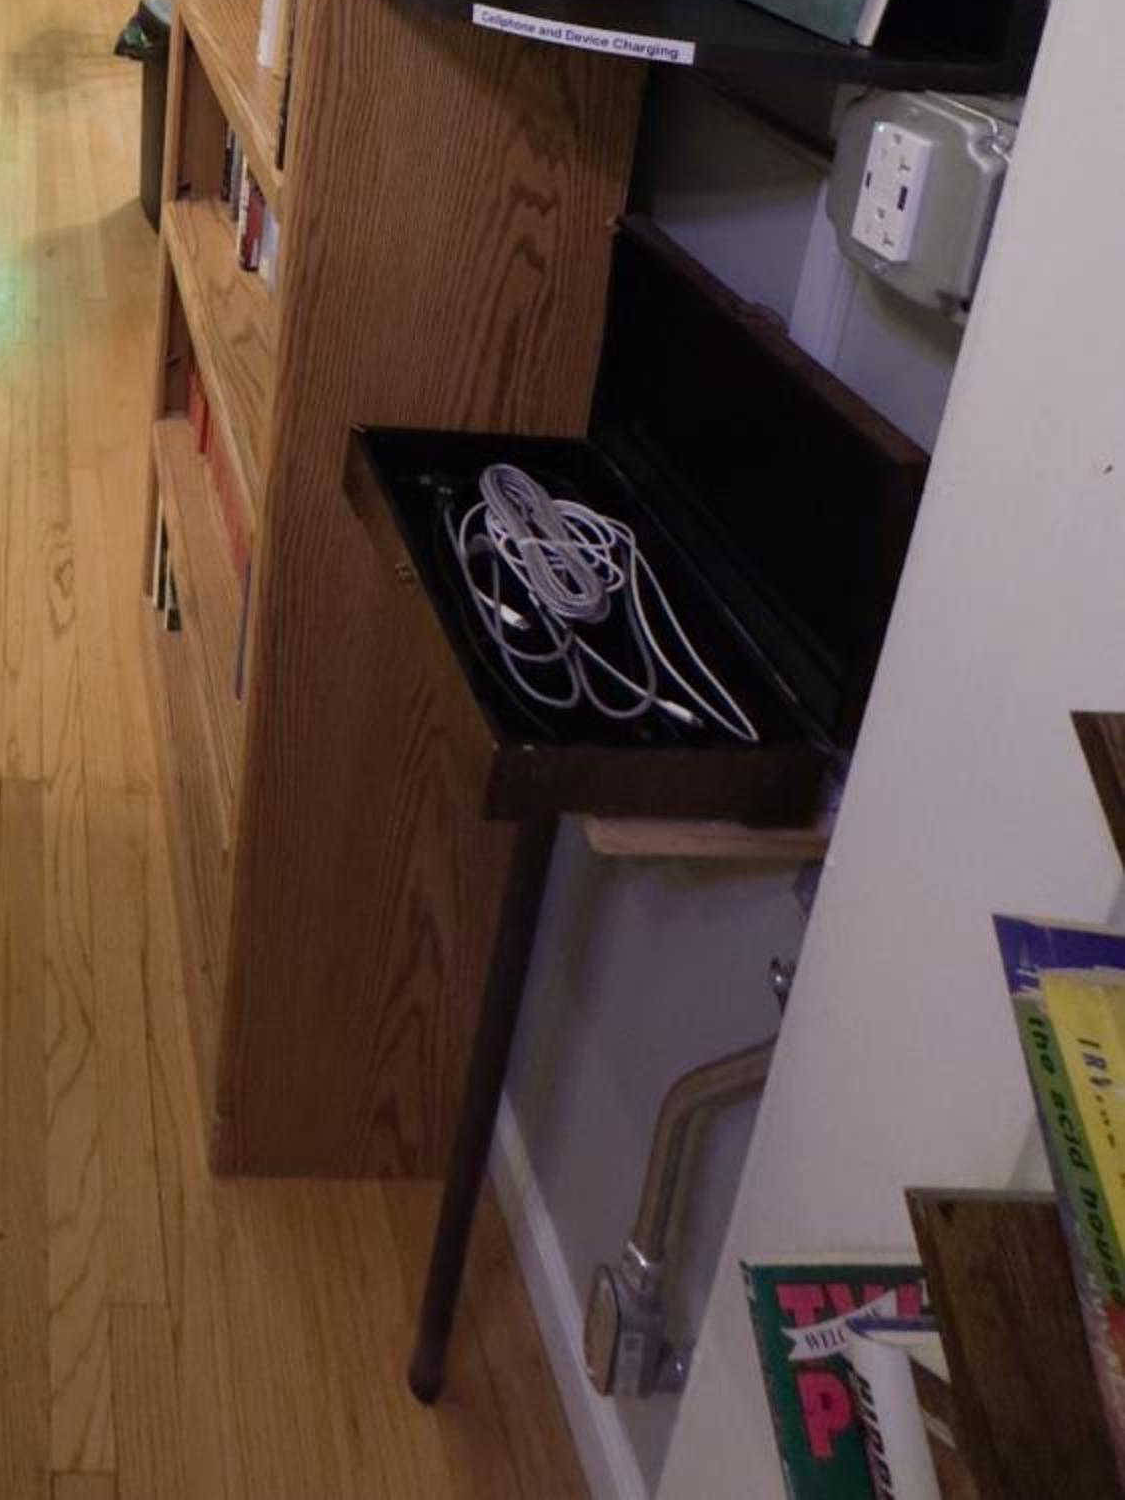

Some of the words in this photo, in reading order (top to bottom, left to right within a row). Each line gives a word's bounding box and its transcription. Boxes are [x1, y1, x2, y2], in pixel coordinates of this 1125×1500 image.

[481, 10, 536, 33] Cellphone
[539, 23, 562, 40] and
[565, 29, 609, 48] Device
[612, 37, 679, 61] Charging
[1029, 1016, 1056, 1074] the
[1049, 1089, 1089, 1174] acid
